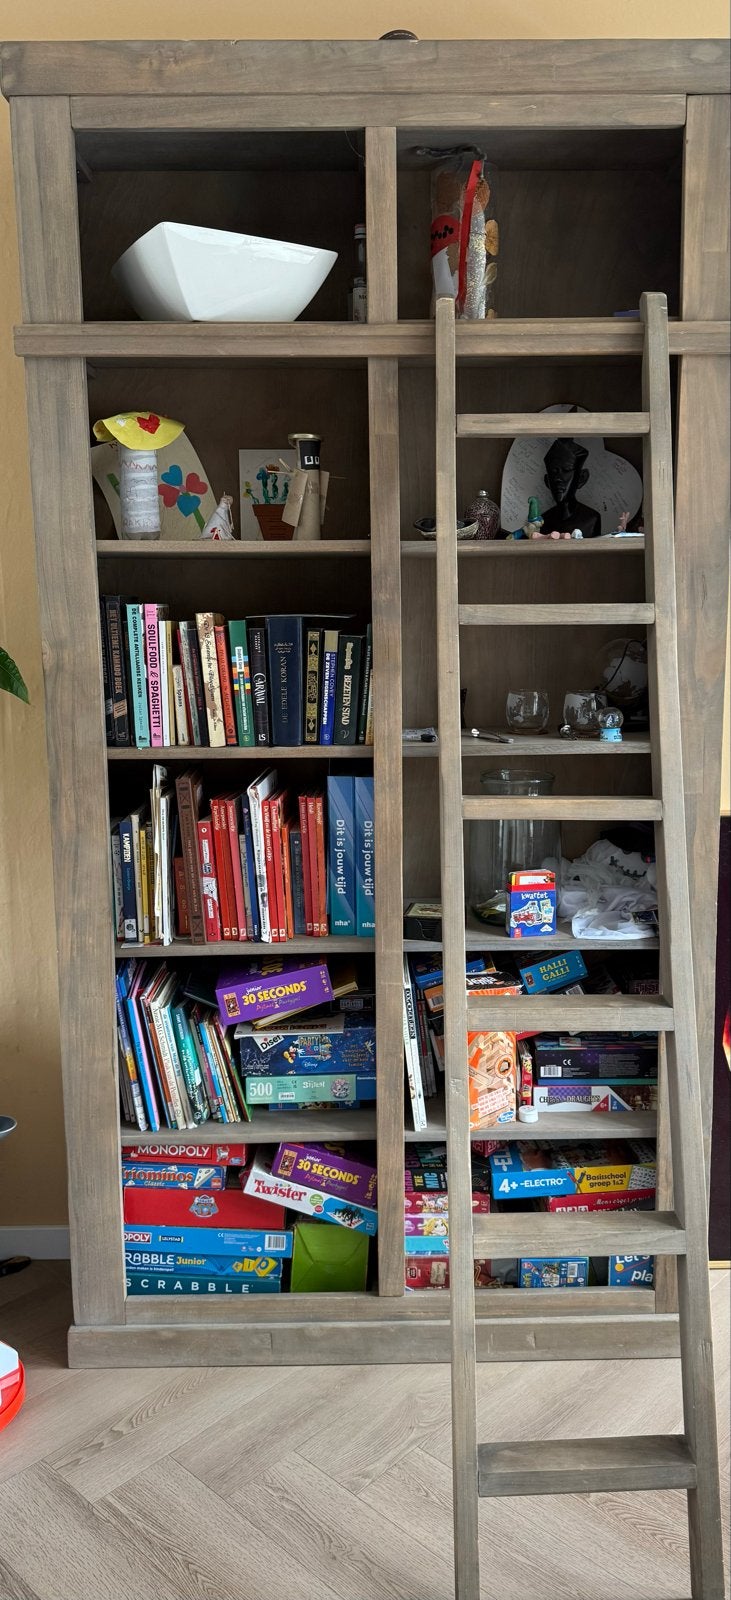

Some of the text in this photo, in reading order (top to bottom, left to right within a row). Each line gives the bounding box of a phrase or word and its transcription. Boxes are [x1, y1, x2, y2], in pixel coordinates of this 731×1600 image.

[147, 624, 157, 668] SOULFOOD
[254, 673, 266, 706] CARAVAL
[150, 680, 160, 728] SPAGHETTI
[342, 675, 352, 725] BEZETEN STAD
[335, 819, 346, 894] Dit is jouw tijd
[362, 821, 374, 896] Dit is jouw tijd
[521, 891, 548, 900] kwartet
[540, 959, 567, 974] HALLI
[542, 966, 570, 981] GALLI
[242, 994, 256, 1006] 30
[257, 981, 306, 1002] SECONDS
[245, 986, 262, 995] junior
[153, 1008, 161, 1023] Annie
[159, 1036, 169, 1057] Schmidt
[260, 1035, 283, 1050] Diset
[250, 1082, 273, 1096] 500
[137, 1144, 209, 1157] MONOPOLY
[297, 1159, 310, 1171] 30
[312, 1164, 359, 1185] SECONDS
[586, 1172, 626, 1181] Basisschool
[414, 1175, 424, 1187] THE
[424, 1172, 439, 1188] MIC
[499, 1179, 518, 1193] 4+
[589, 1180, 611, 1188] groep
[254, 1179, 307, 1201] Twister
[124, 1233, 150, 1242] OPOLY
[125, 1253, 206, 1265] RABBLE Junior
[632, 1270, 653, 1281] pla
[126, 1278, 249, 1293] SCRABBLE
